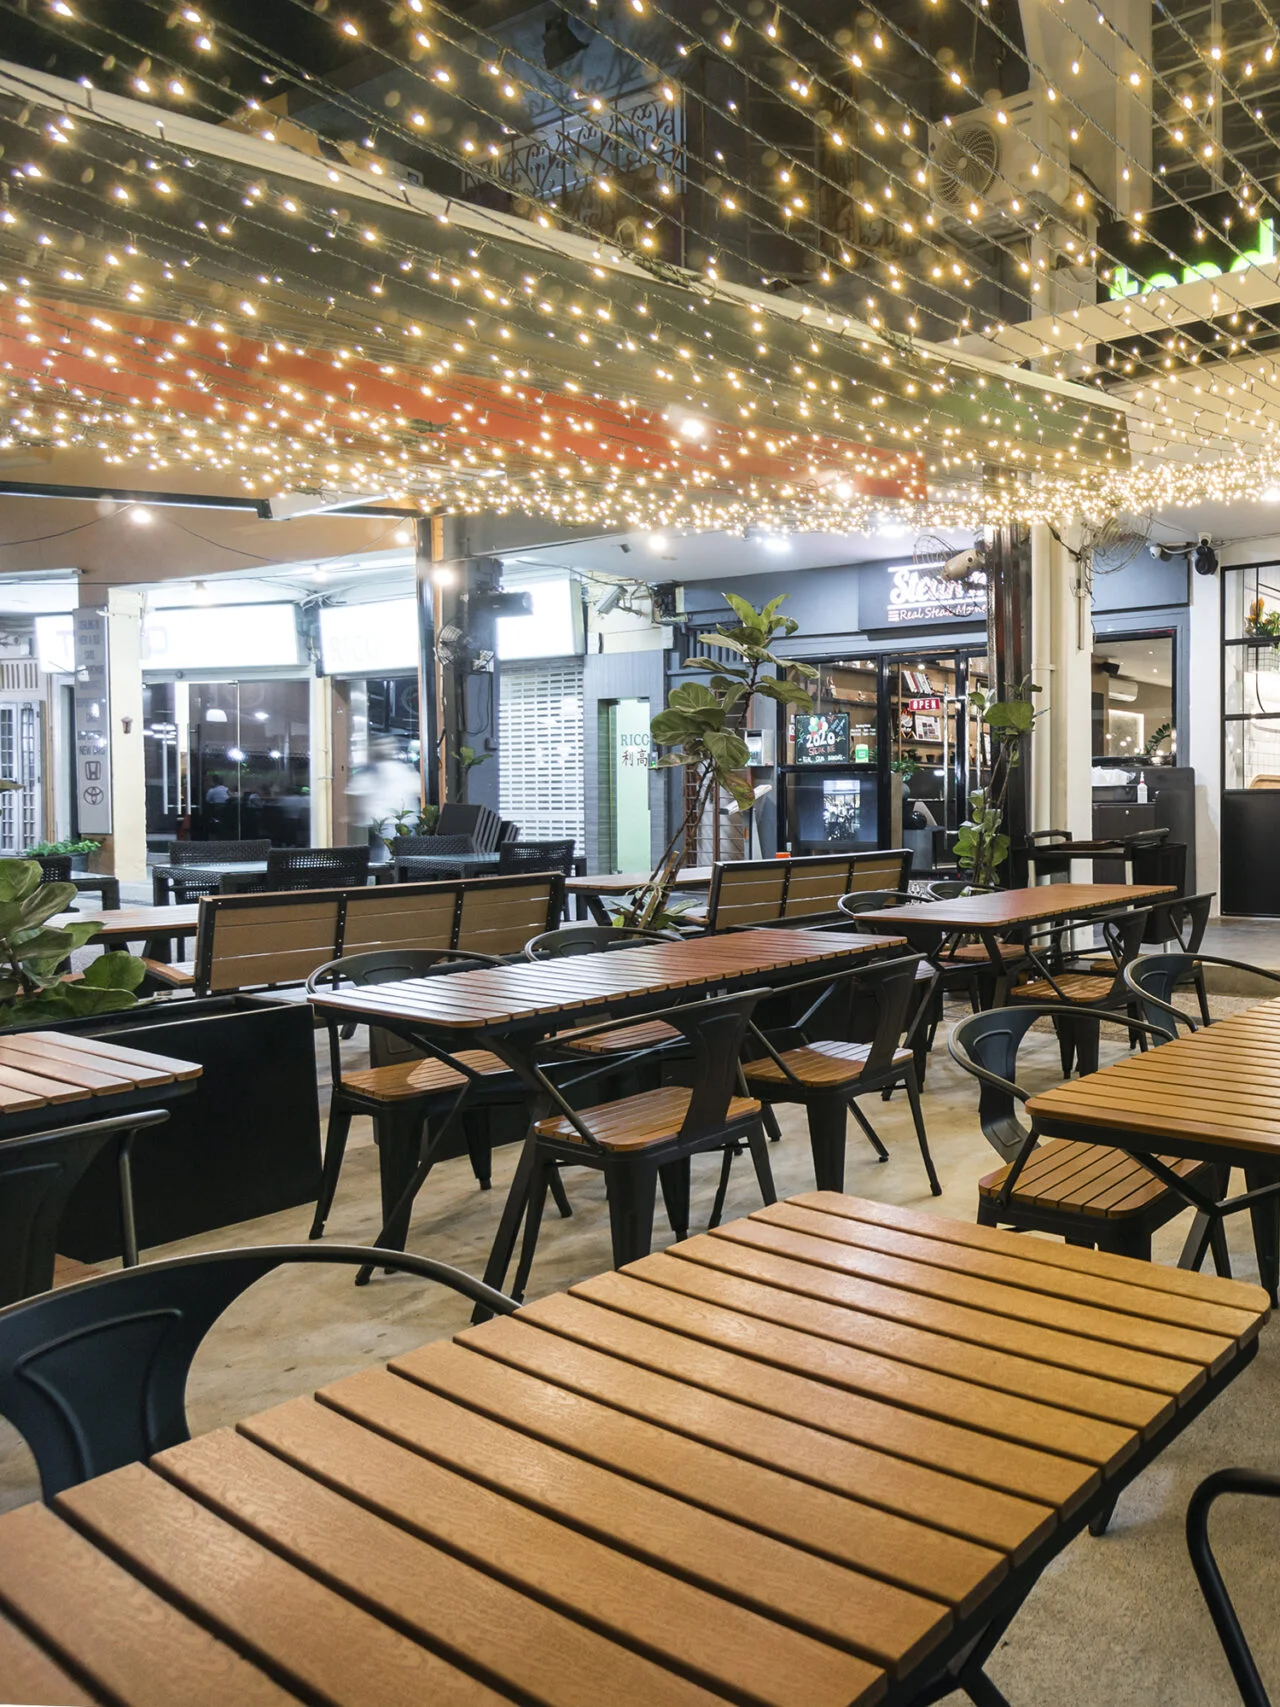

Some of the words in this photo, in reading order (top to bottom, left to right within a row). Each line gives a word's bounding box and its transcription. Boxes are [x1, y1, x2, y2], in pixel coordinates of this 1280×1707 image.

[912, 700, 938, 710] OPEN
[806, 729, 836, 748] 2020
[622, 749, 648, 767] 利高
